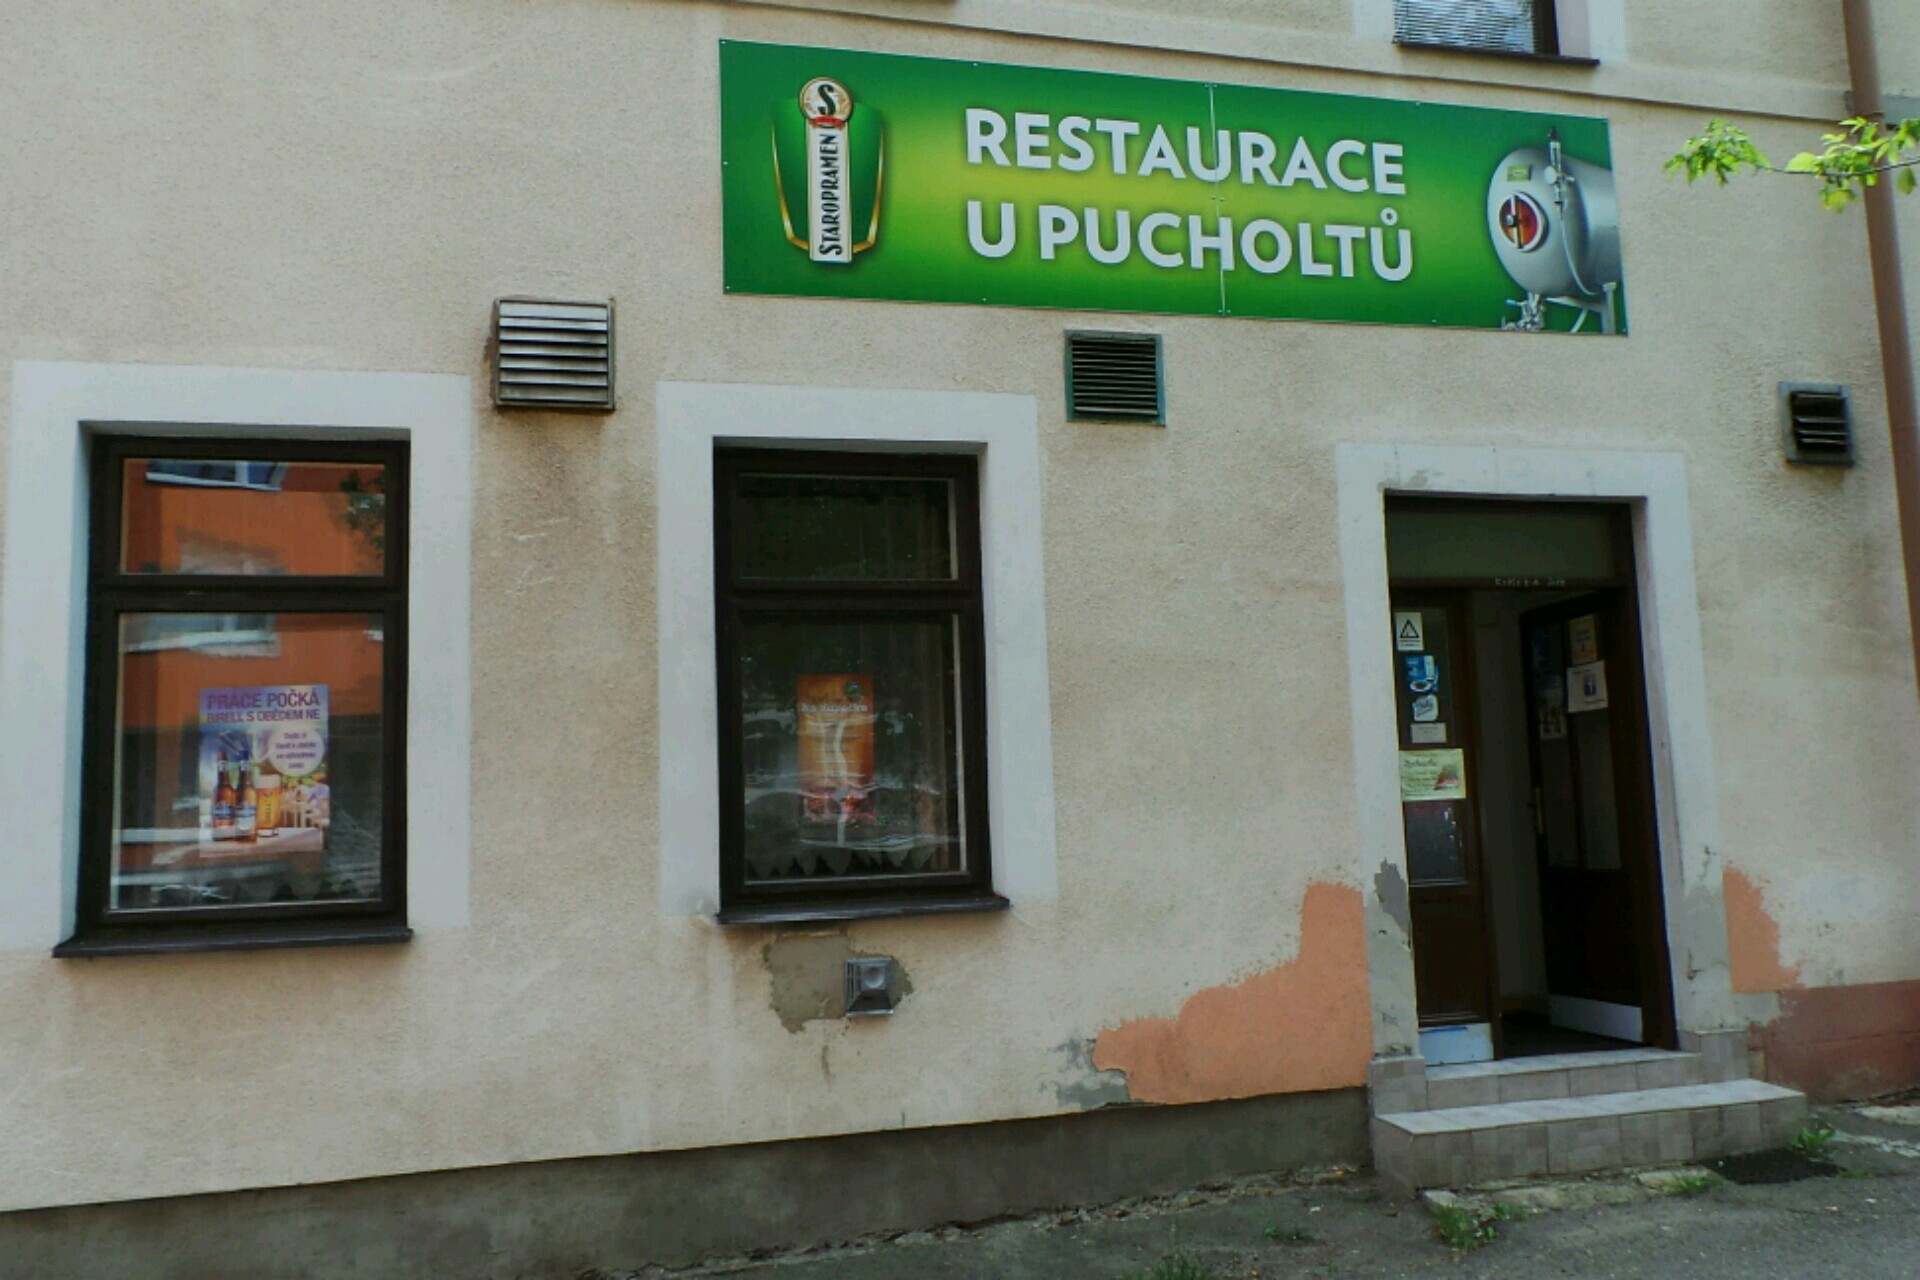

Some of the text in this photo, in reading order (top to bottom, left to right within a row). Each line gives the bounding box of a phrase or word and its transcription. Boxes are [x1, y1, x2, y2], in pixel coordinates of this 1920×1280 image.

[965, 107, 1406, 195] RESTAURACE
[818, 133, 843, 256] STAROPRAMEN
[967, 199, 1413, 282] U PUCHOLTŮ
[305, 709, 320, 720] NE
